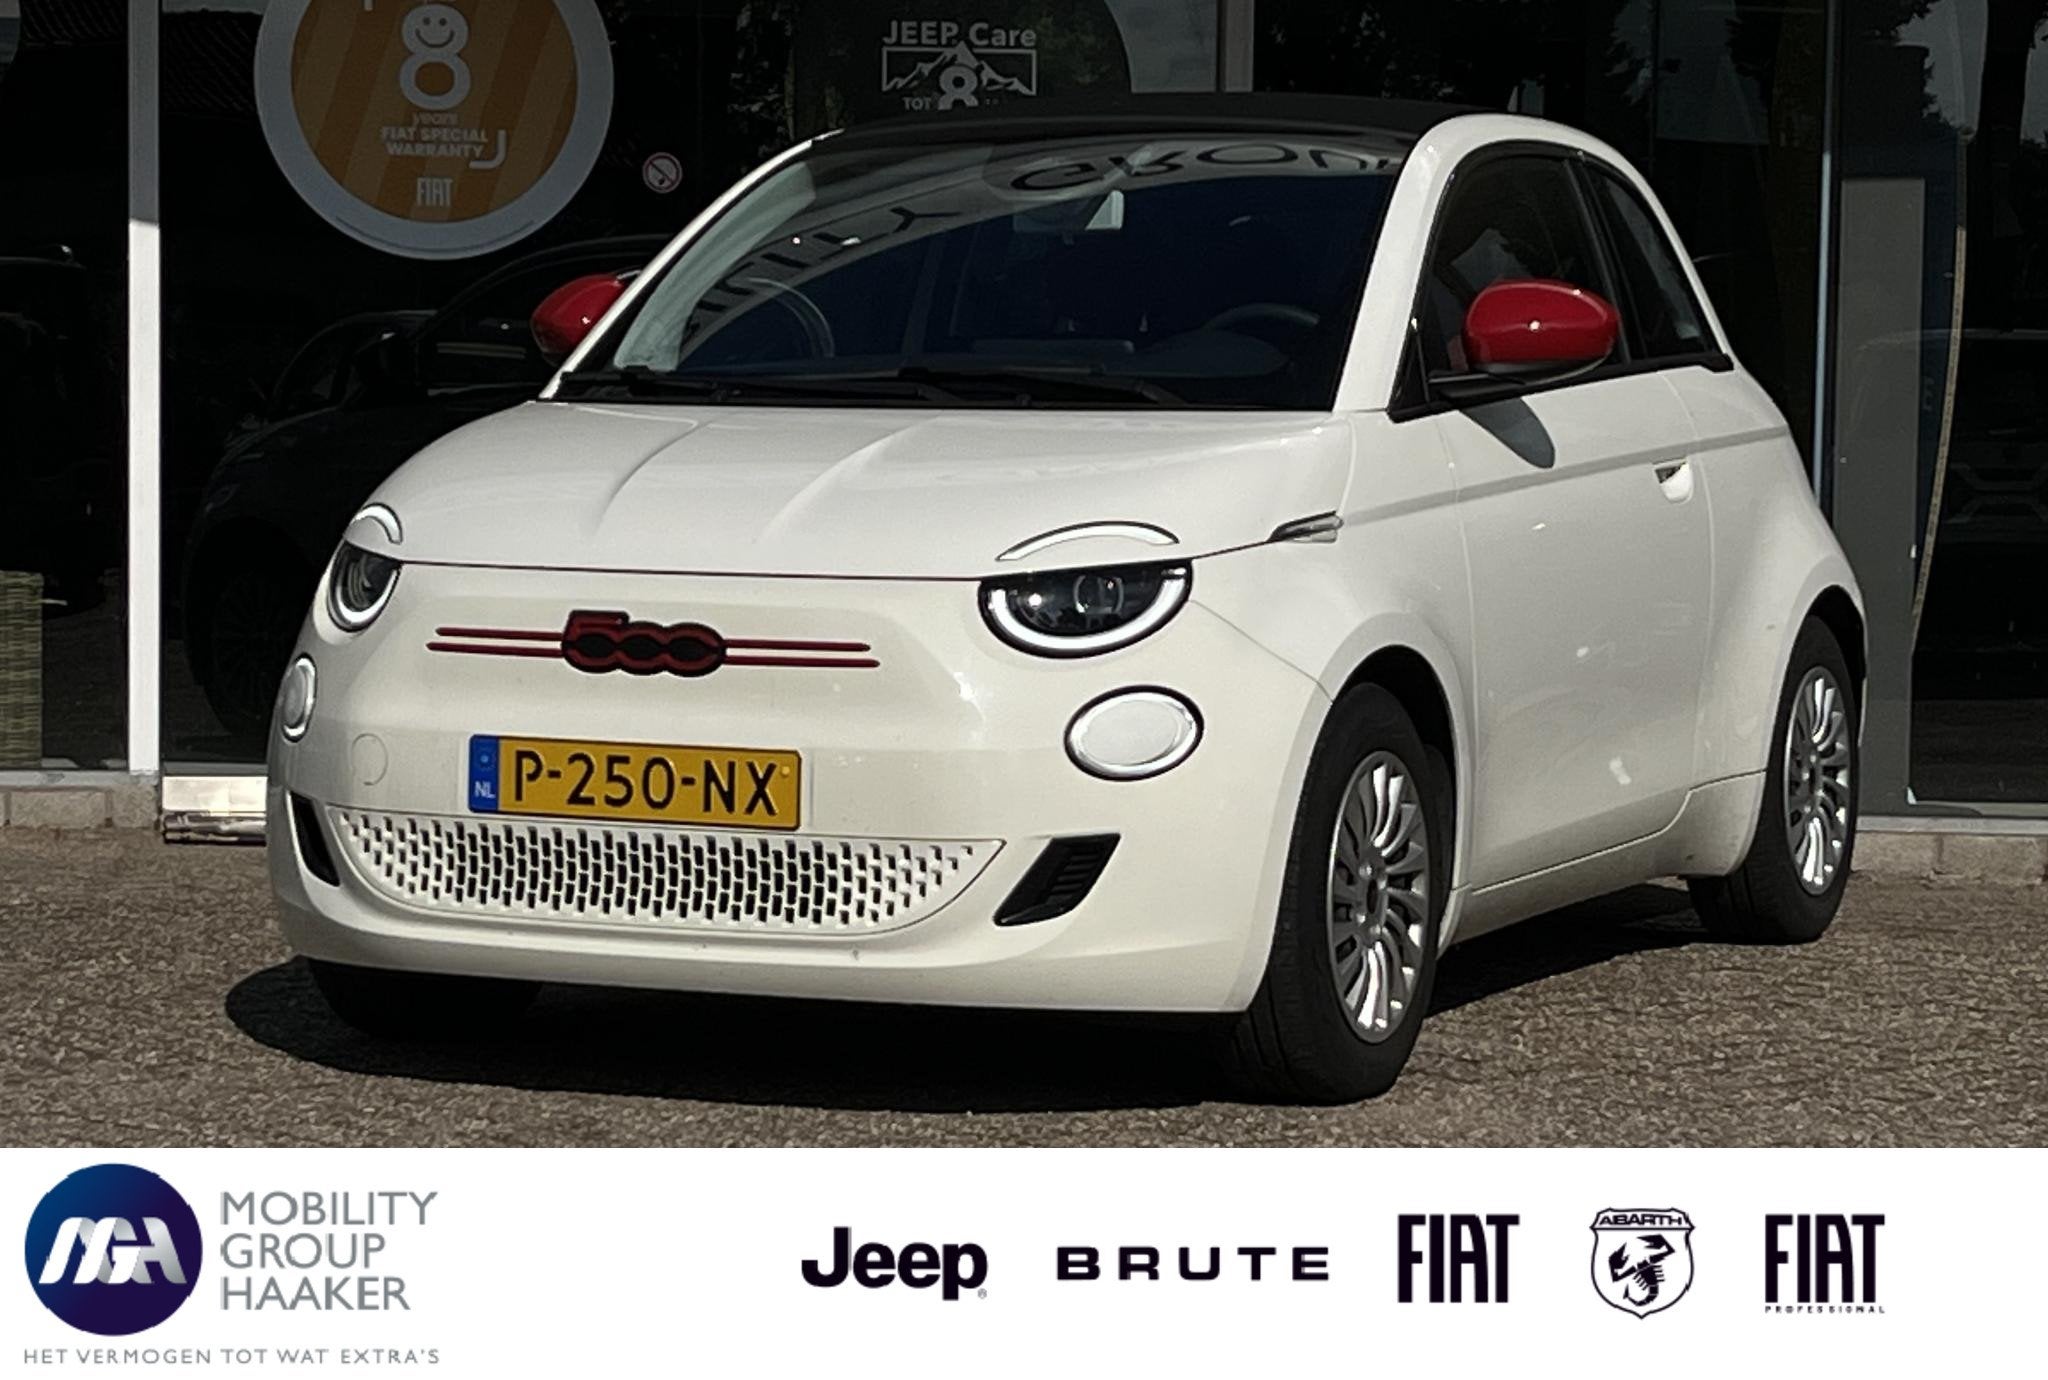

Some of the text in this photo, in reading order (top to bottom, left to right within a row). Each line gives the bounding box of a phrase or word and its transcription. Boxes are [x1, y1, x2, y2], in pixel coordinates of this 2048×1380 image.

[969, 22, 1037, 47] Care
[401, 3, 470, 110] 8
[382, 126, 488, 142] FIAT SPECIAL
[386, 142, 484, 157] WARRANTY
[417, 177, 453, 207] FIAT
[562, 610, 727, 677] 500
[475, 780, 496, 799] NL
[514, 750, 778, 816] P-250-NX
